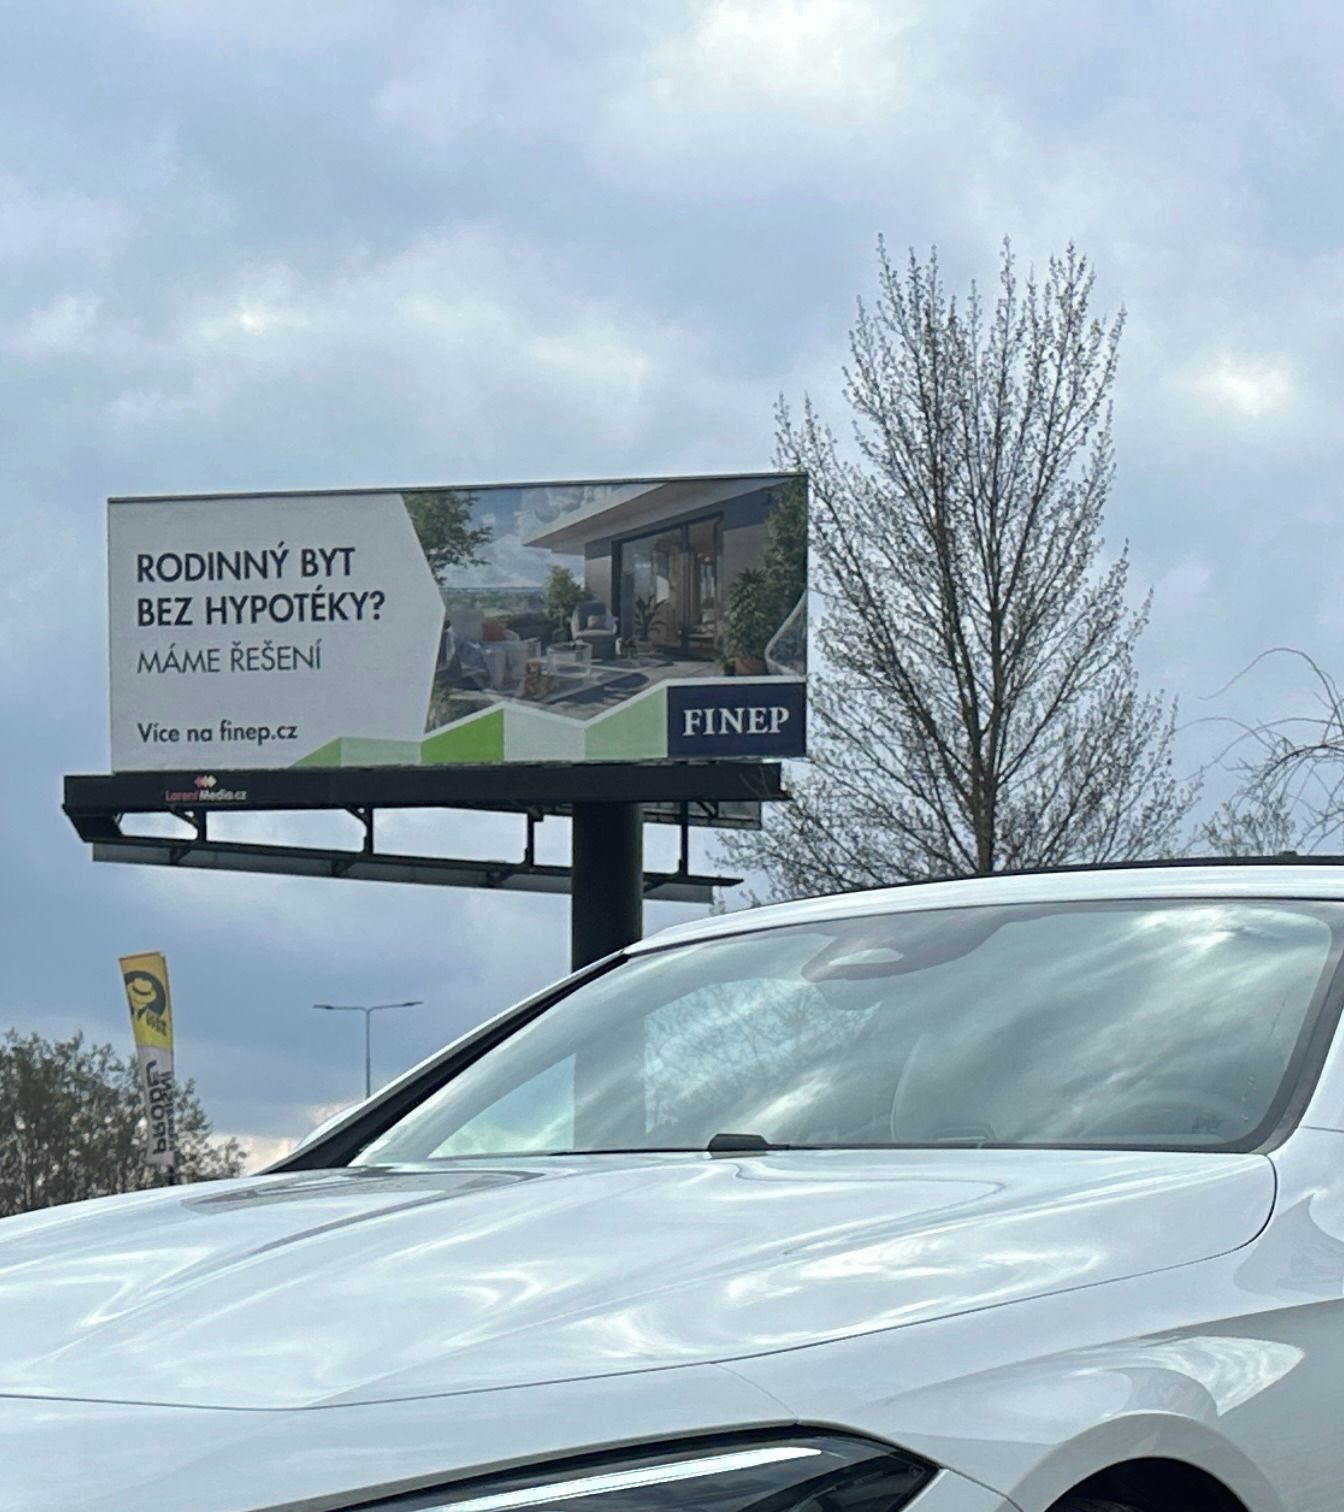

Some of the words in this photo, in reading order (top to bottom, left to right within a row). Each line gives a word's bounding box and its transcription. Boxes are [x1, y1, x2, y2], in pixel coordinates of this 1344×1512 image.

[137, 541, 289, 582] RODINNÝ
[301, 547, 355, 578] BYT
[137, 597, 193, 627] BEZ
[206, 585, 385, 625] HYPOTÉKY?
[137, 643, 220, 674] MÁME
[230, 639, 322, 672] ŘEŠENÍ
[137, 722, 180, 742] Více
[187, 728, 212, 742] na
[220, 718, 298, 746] finep.cz
[682, 706, 790, 736] FINEP
